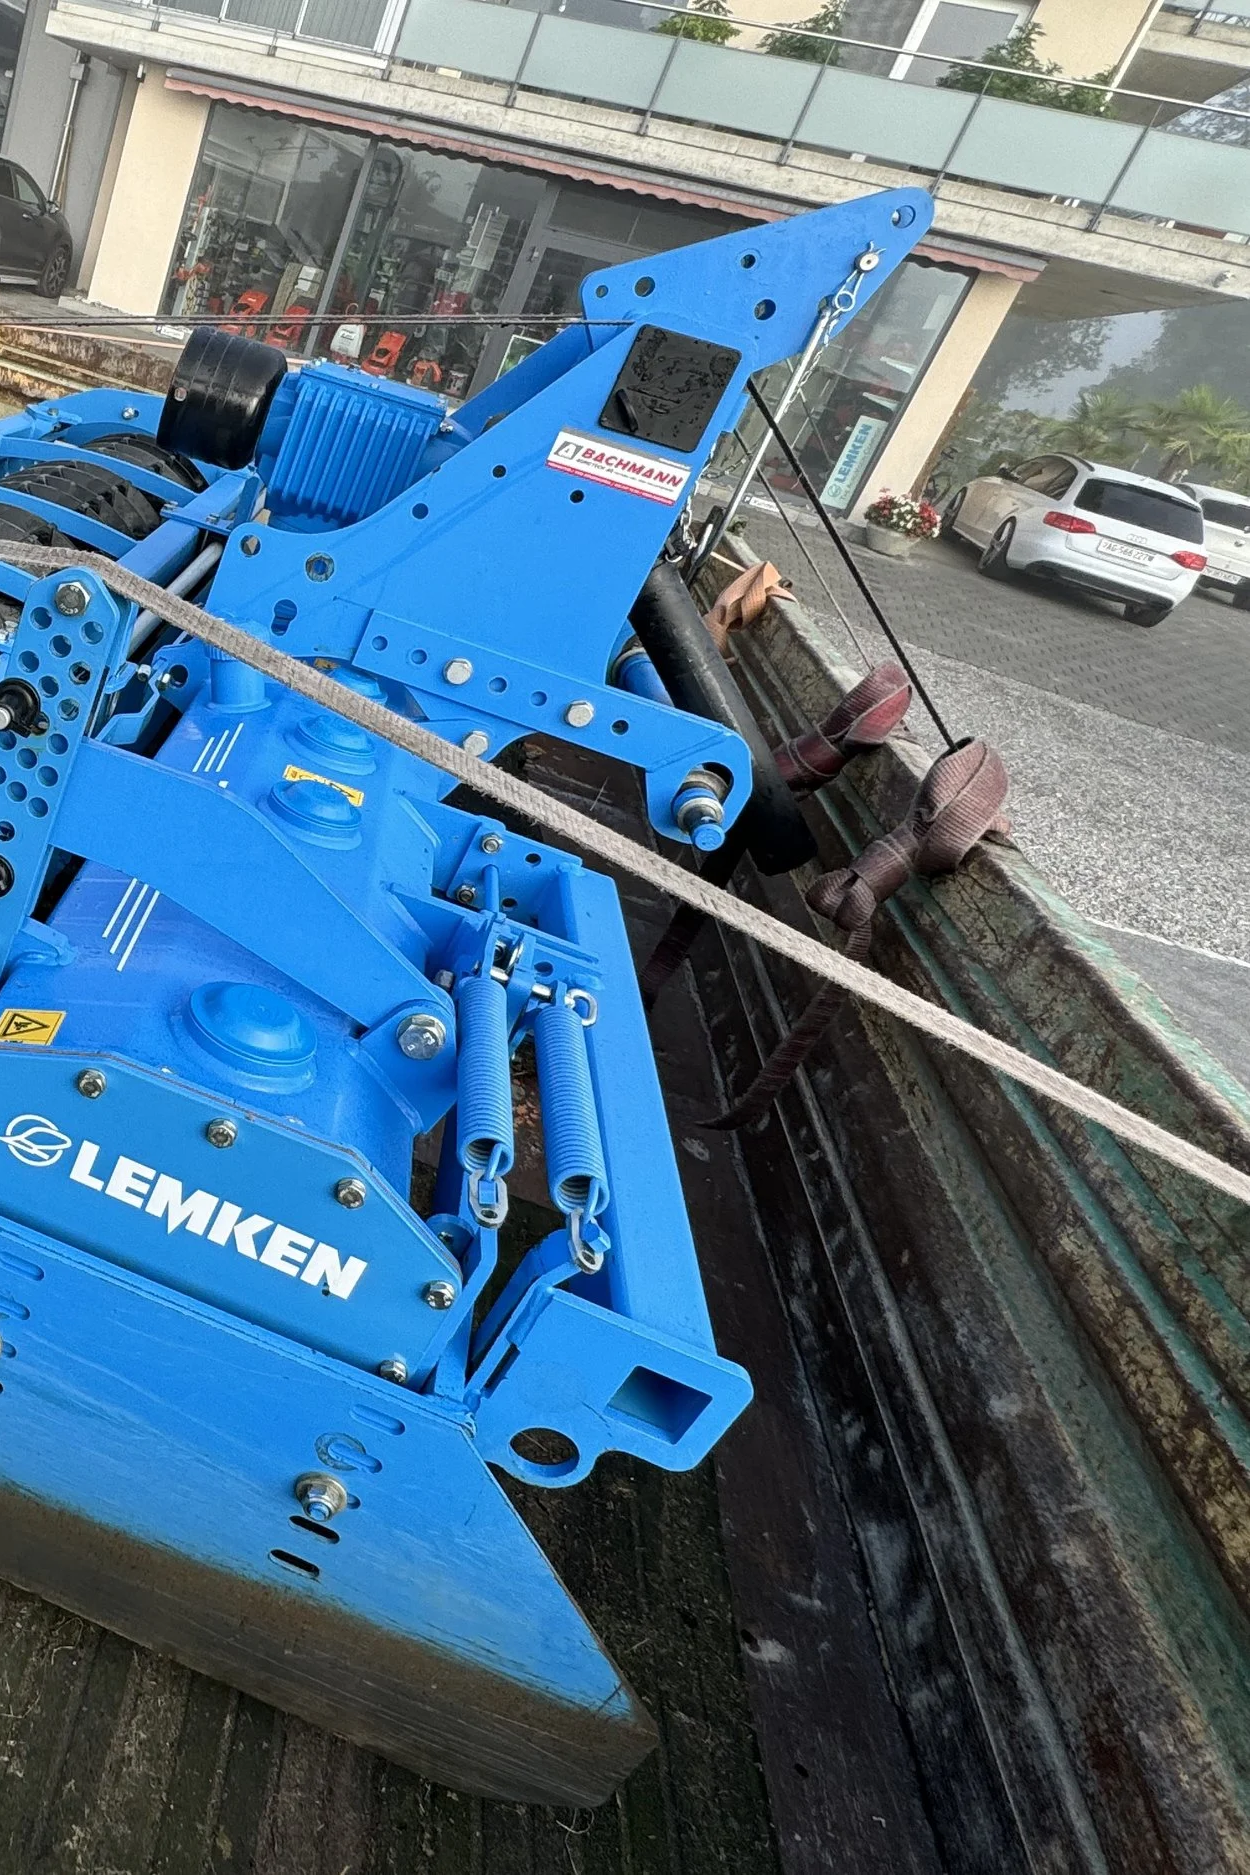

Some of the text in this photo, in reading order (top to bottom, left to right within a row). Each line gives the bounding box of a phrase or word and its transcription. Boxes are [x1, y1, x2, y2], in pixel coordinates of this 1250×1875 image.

[582, 448, 683, 487] BACHMANN
[834, 423, 873, 484] LEMKEN
[69, 1139, 368, 1300] LEMKEN
